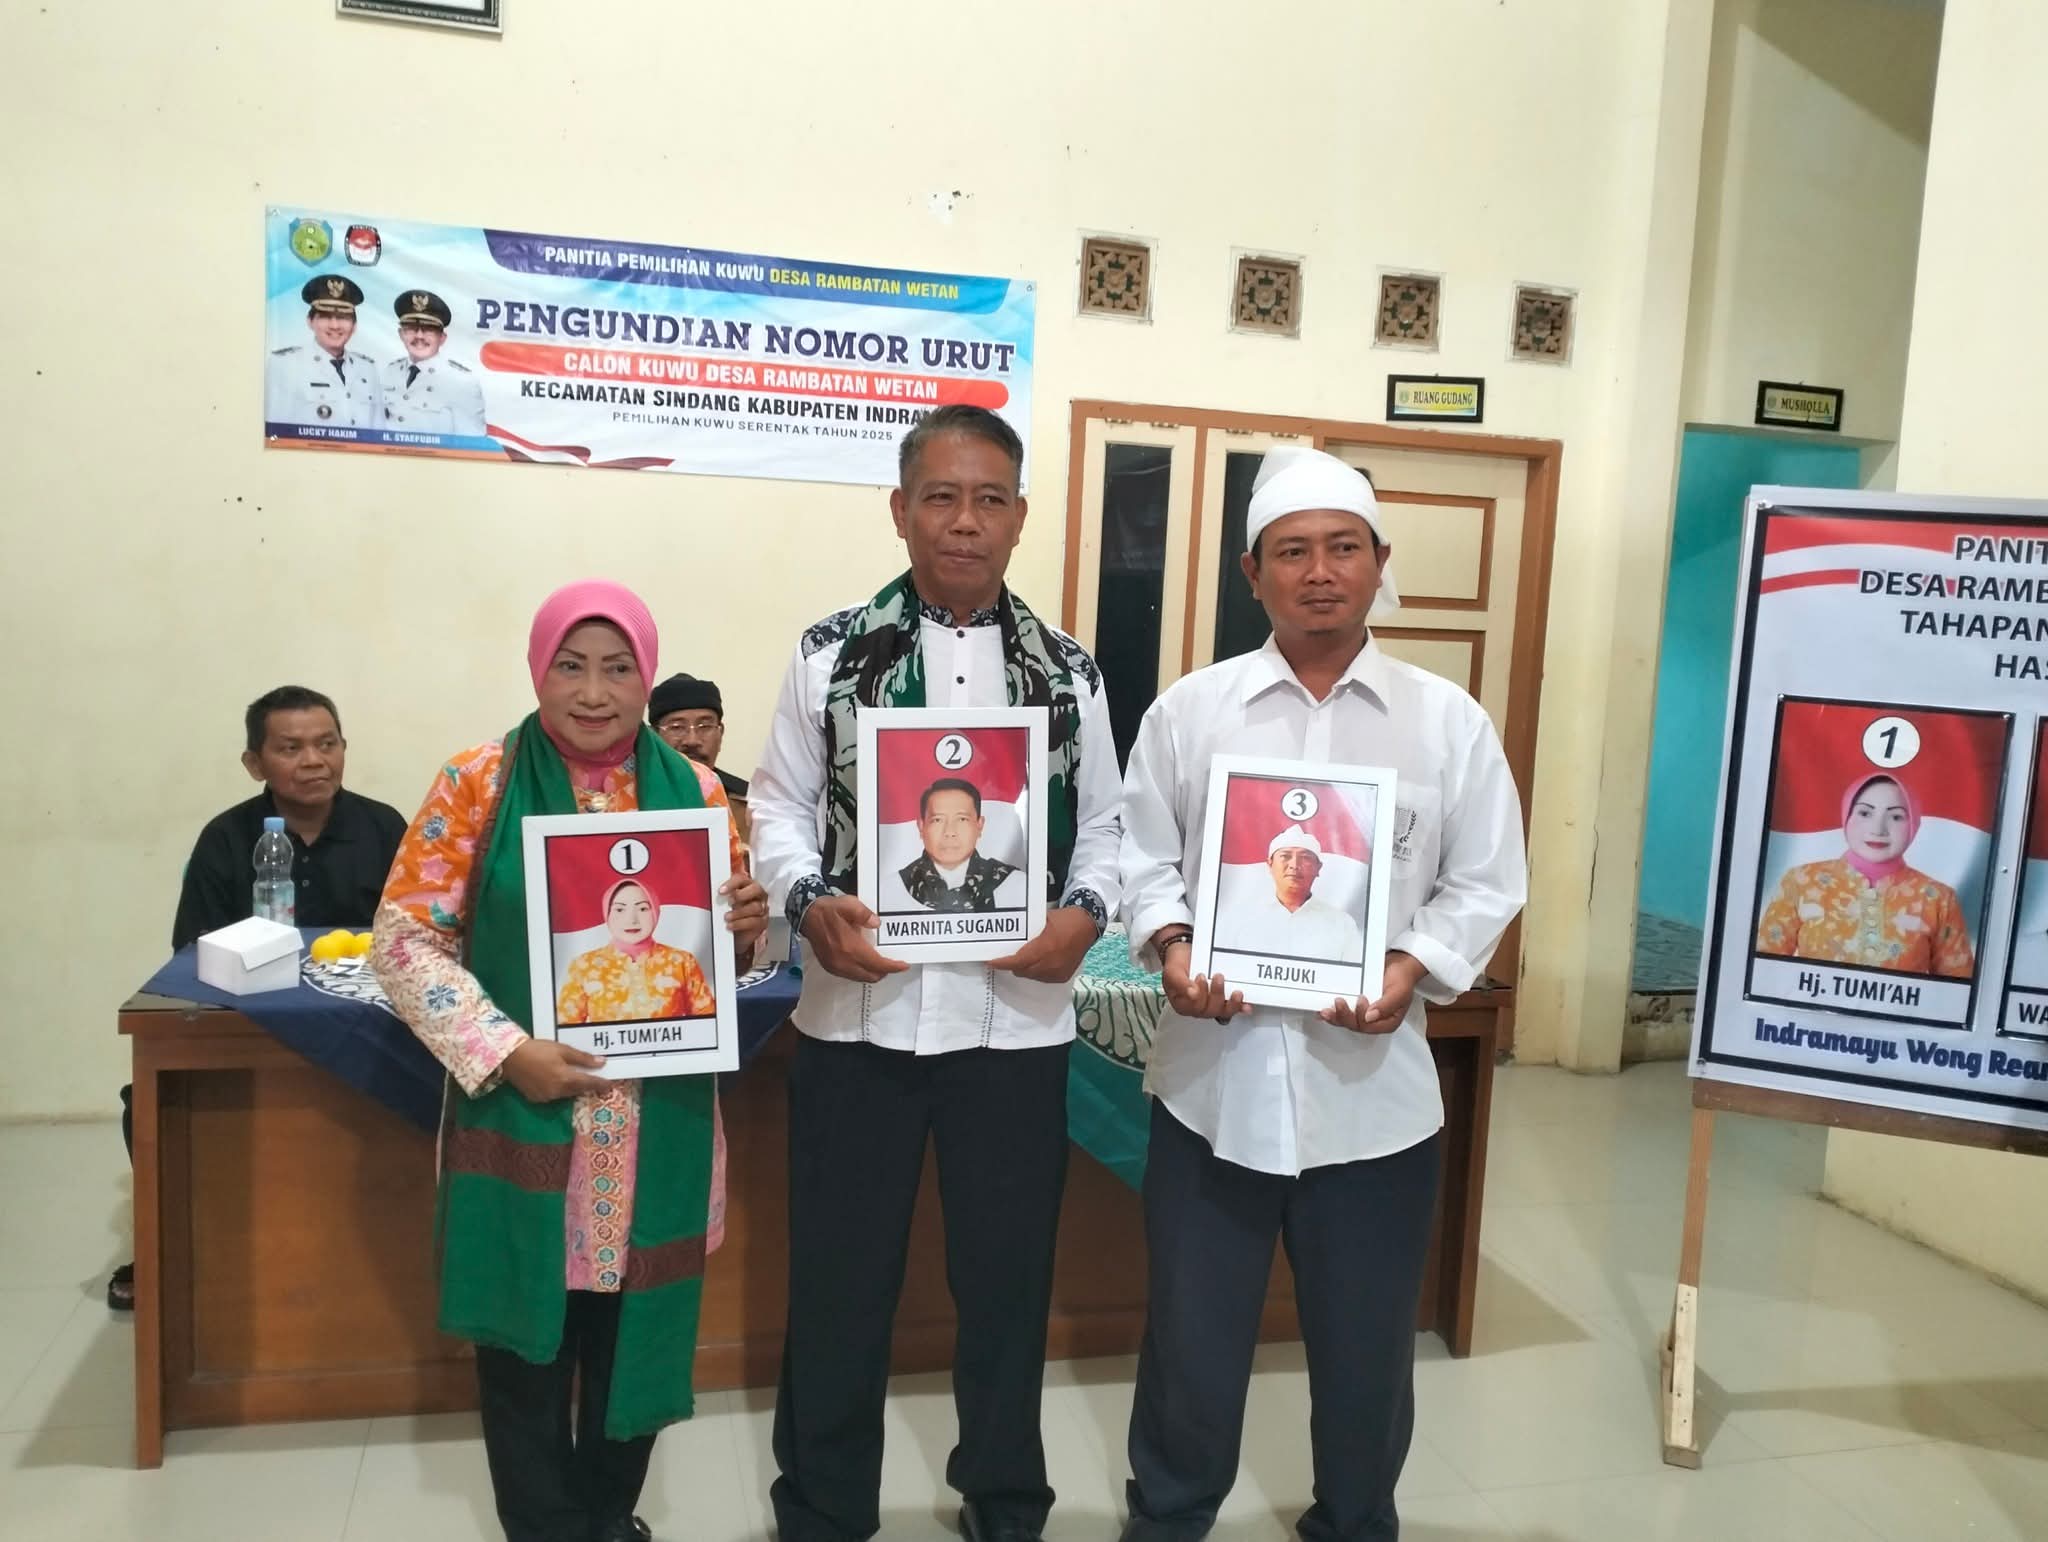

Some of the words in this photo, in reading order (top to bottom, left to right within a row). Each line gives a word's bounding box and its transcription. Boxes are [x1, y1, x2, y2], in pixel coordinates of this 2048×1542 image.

[544, 246, 612, 267] PANITIA
[617, 252, 710, 276] PEMILIHAN
[716, 263, 764, 282] KUWU
[770, 268, 810, 287] DESA
[816, 273, 900, 295] RAMBATAN
[906, 282, 959, 299] WETAN
[476, 298, 752, 351] PENGUNDIAN
[765, 324, 909, 366] NOMOR
[921, 338, 1015, 372] URUT
[563, 352, 631, 376] CALON
[638, 358, 699, 381] KUWU
[705, 364, 756, 385] DESA
[763, 368, 868, 394] RAMBATAN
[874, 377, 938, 400] WETAN
[520, 380, 646, 406] KECAMATAN
[652, 389, 740, 412] SINDANG
[747, 396, 859, 421] KABUPATEN
[865, 406, 928, 425] INDRA
[1413, 391, 1440, 404] RUANG
[1441, 391, 1473, 406] GUDANG
[1780, 397, 1830, 415] MUSHOLLA
[298, 427, 326, 437] LUCKY
[328, 428, 357, 439] HAKIM
[612, 411, 690, 427] PEMILIHAN
[694, 417, 734, 431] KUWU
[738, 420, 810, 436] SERENTAK
[814, 426, 858, 439] TAHUN
[861, 430, 893, 441] 2025
[1860, 570, 1946, 598] DESA
[1994, 653, 2048, 681] HA
[945, 738, 962, 765] 2
[1879, 726, 1899, 759] 1
[1290, 791, 1308, 817] 3
[622, 843, 635, 871] 1
[886, 920, 952, 937] WARNITA
[956, 917, 1020, 934] SUGANDI
[1256, 963, 1316, 984] TARJUKI
[1799, 971, 1827, 998] Hj.
[1832, 976, 1921, 1007] TUMI'AH
[593, 1031, 615, 1050] Hj.
[618, 1026, 683, 1046] TUMI'AH
[1755, 1017, 1898, 1064] Indramayu
[1906, 1038, 1984, 1079] Wong
